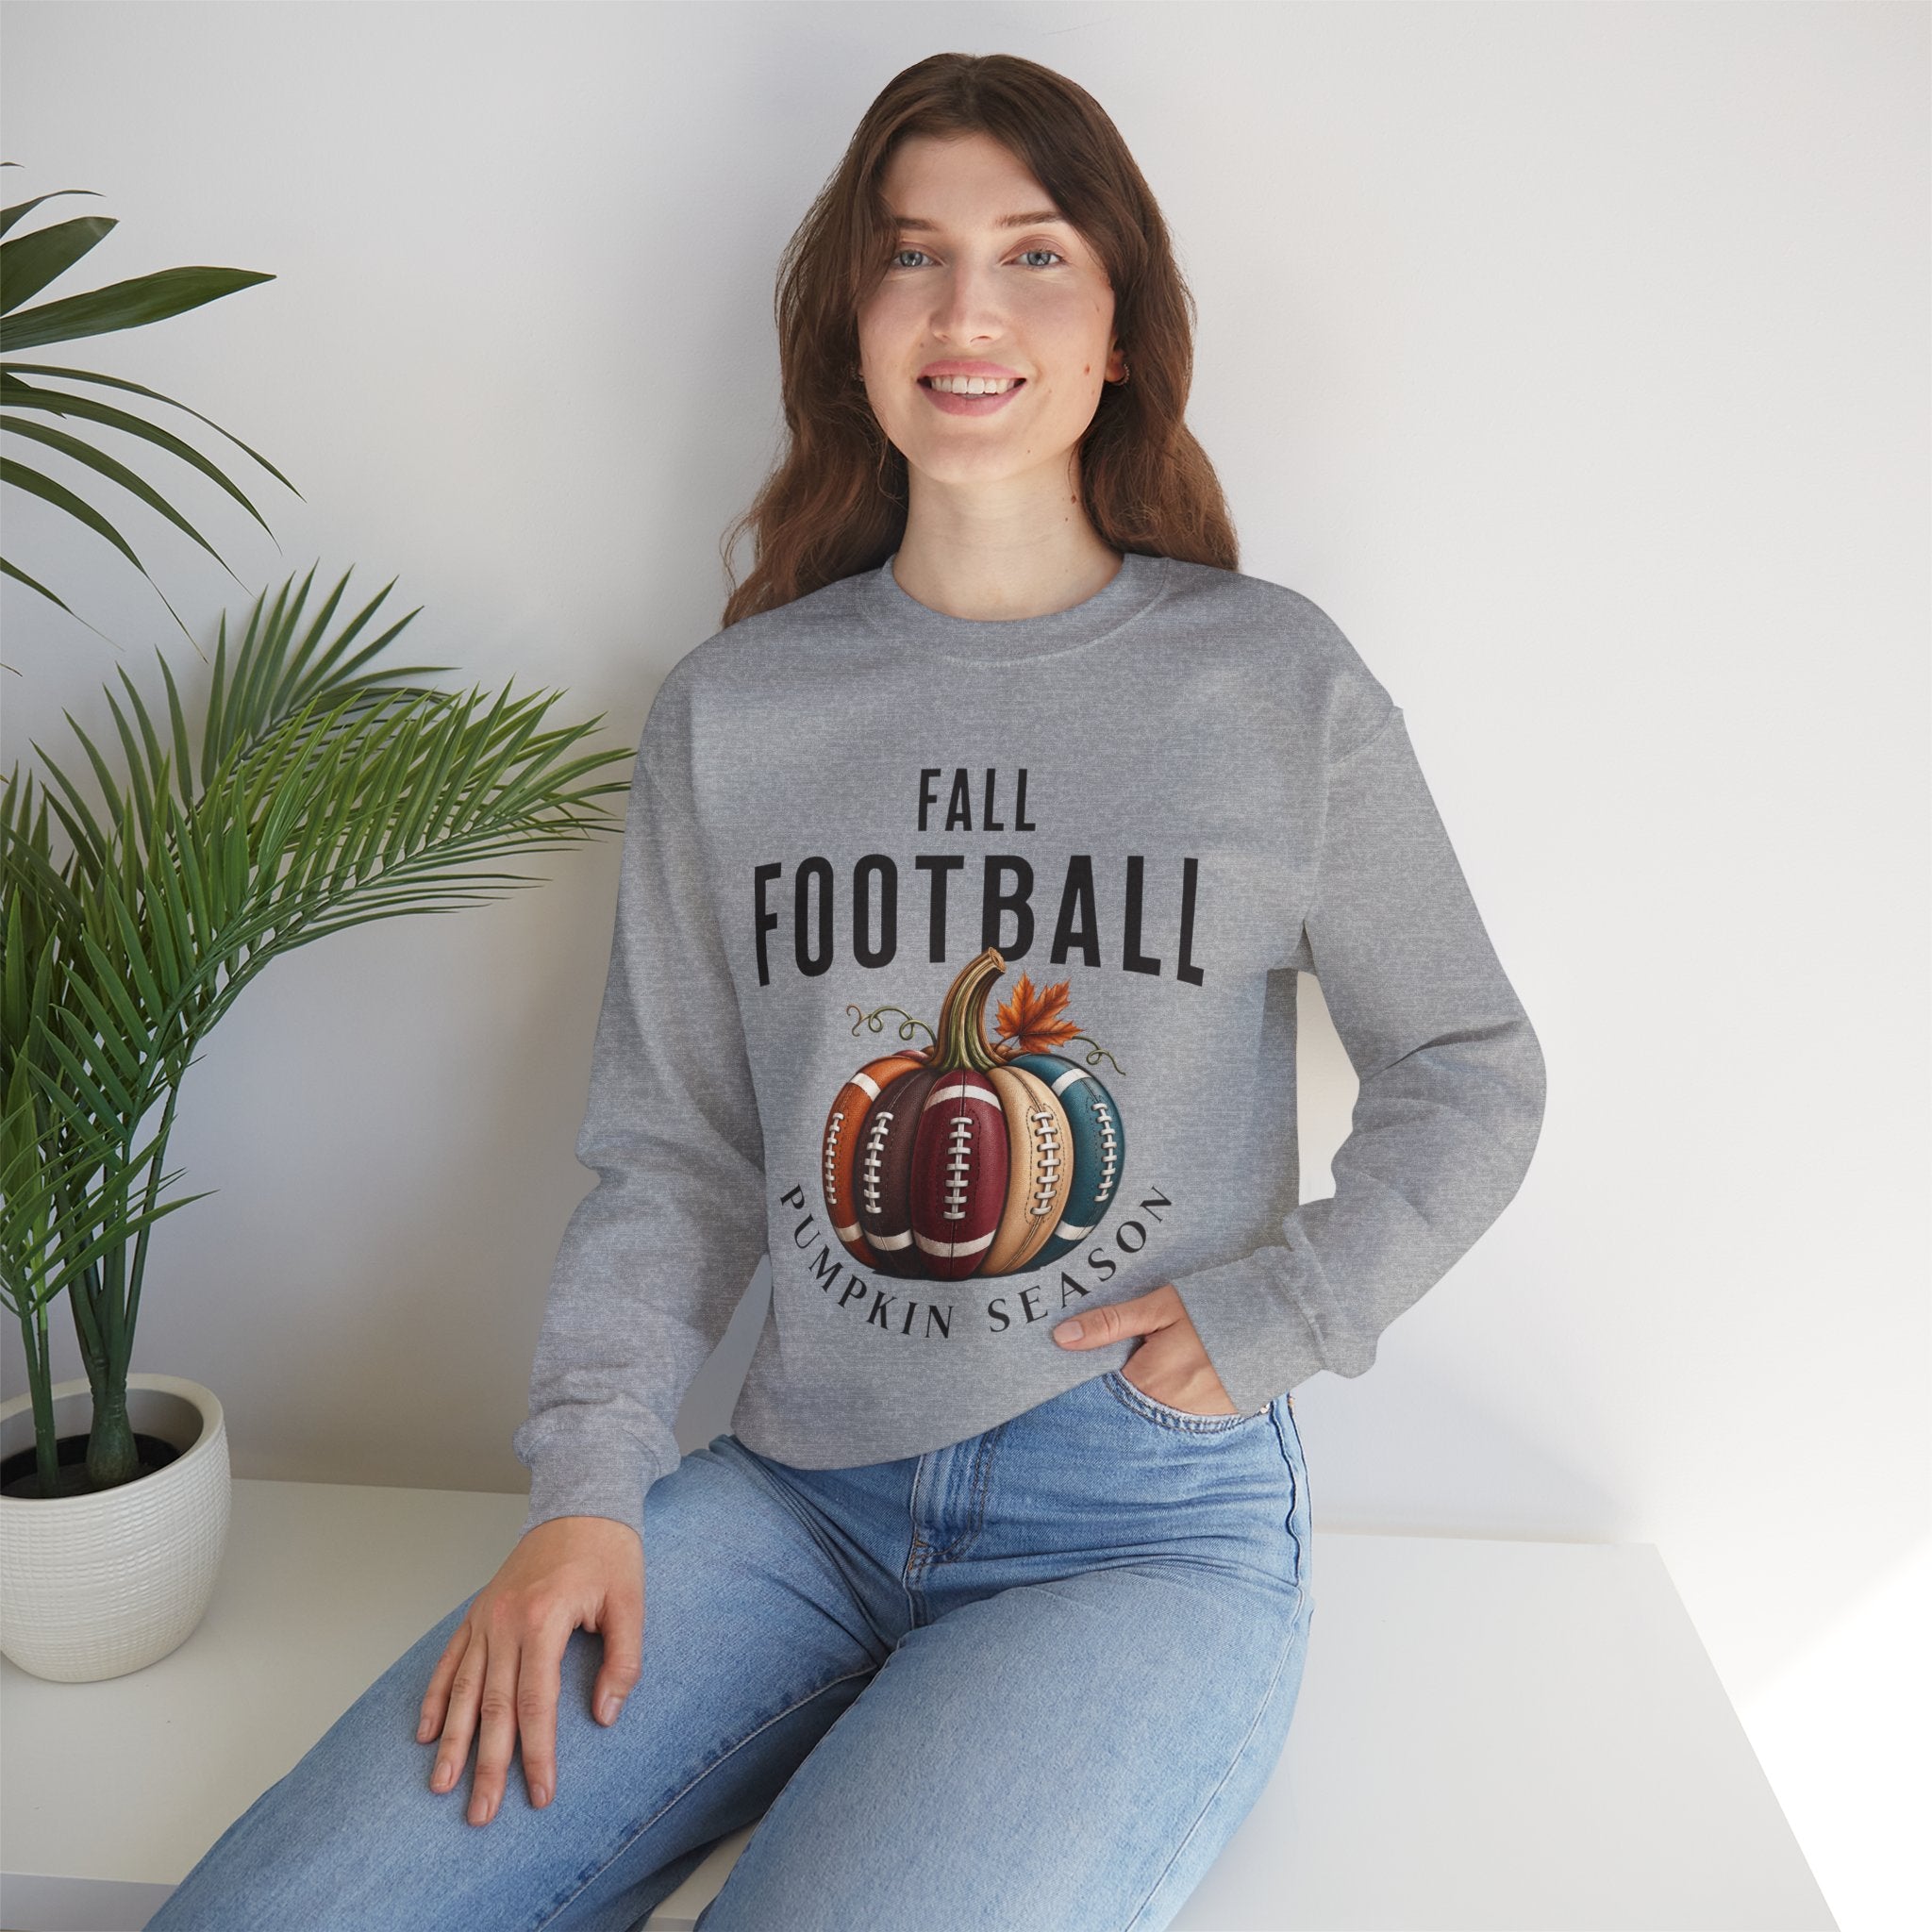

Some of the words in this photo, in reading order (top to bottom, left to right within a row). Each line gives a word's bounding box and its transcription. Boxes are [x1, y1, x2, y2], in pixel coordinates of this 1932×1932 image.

[917, 768, 1037, 832] FALL
[754, 854, 1205, 988] FOOTBALL
[779, 1183, 953, 1340] PUMPKIN
[987, 1185, 1173, 1334] SEASON
